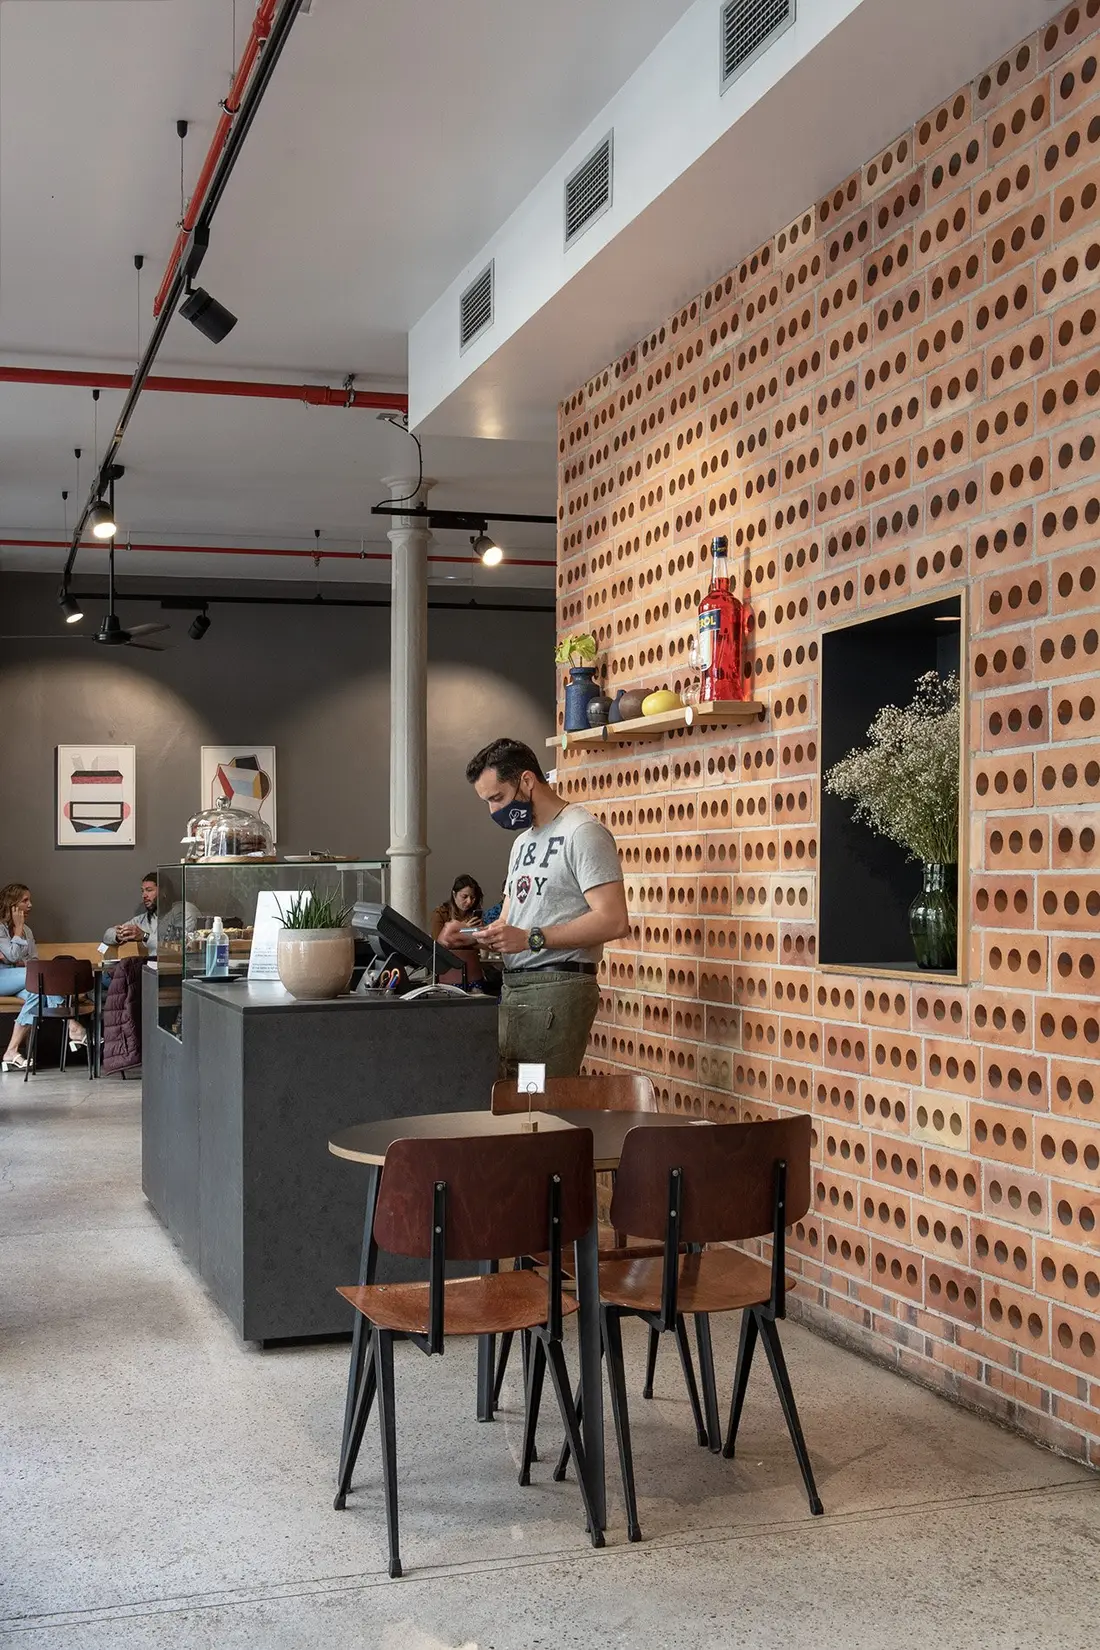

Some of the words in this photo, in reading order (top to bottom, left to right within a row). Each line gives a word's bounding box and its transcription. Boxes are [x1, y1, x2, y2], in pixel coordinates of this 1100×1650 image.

[523, 842, 536, 867] &
[539, 836, 565, 868] F
[534, 876, 548, 896] Y
